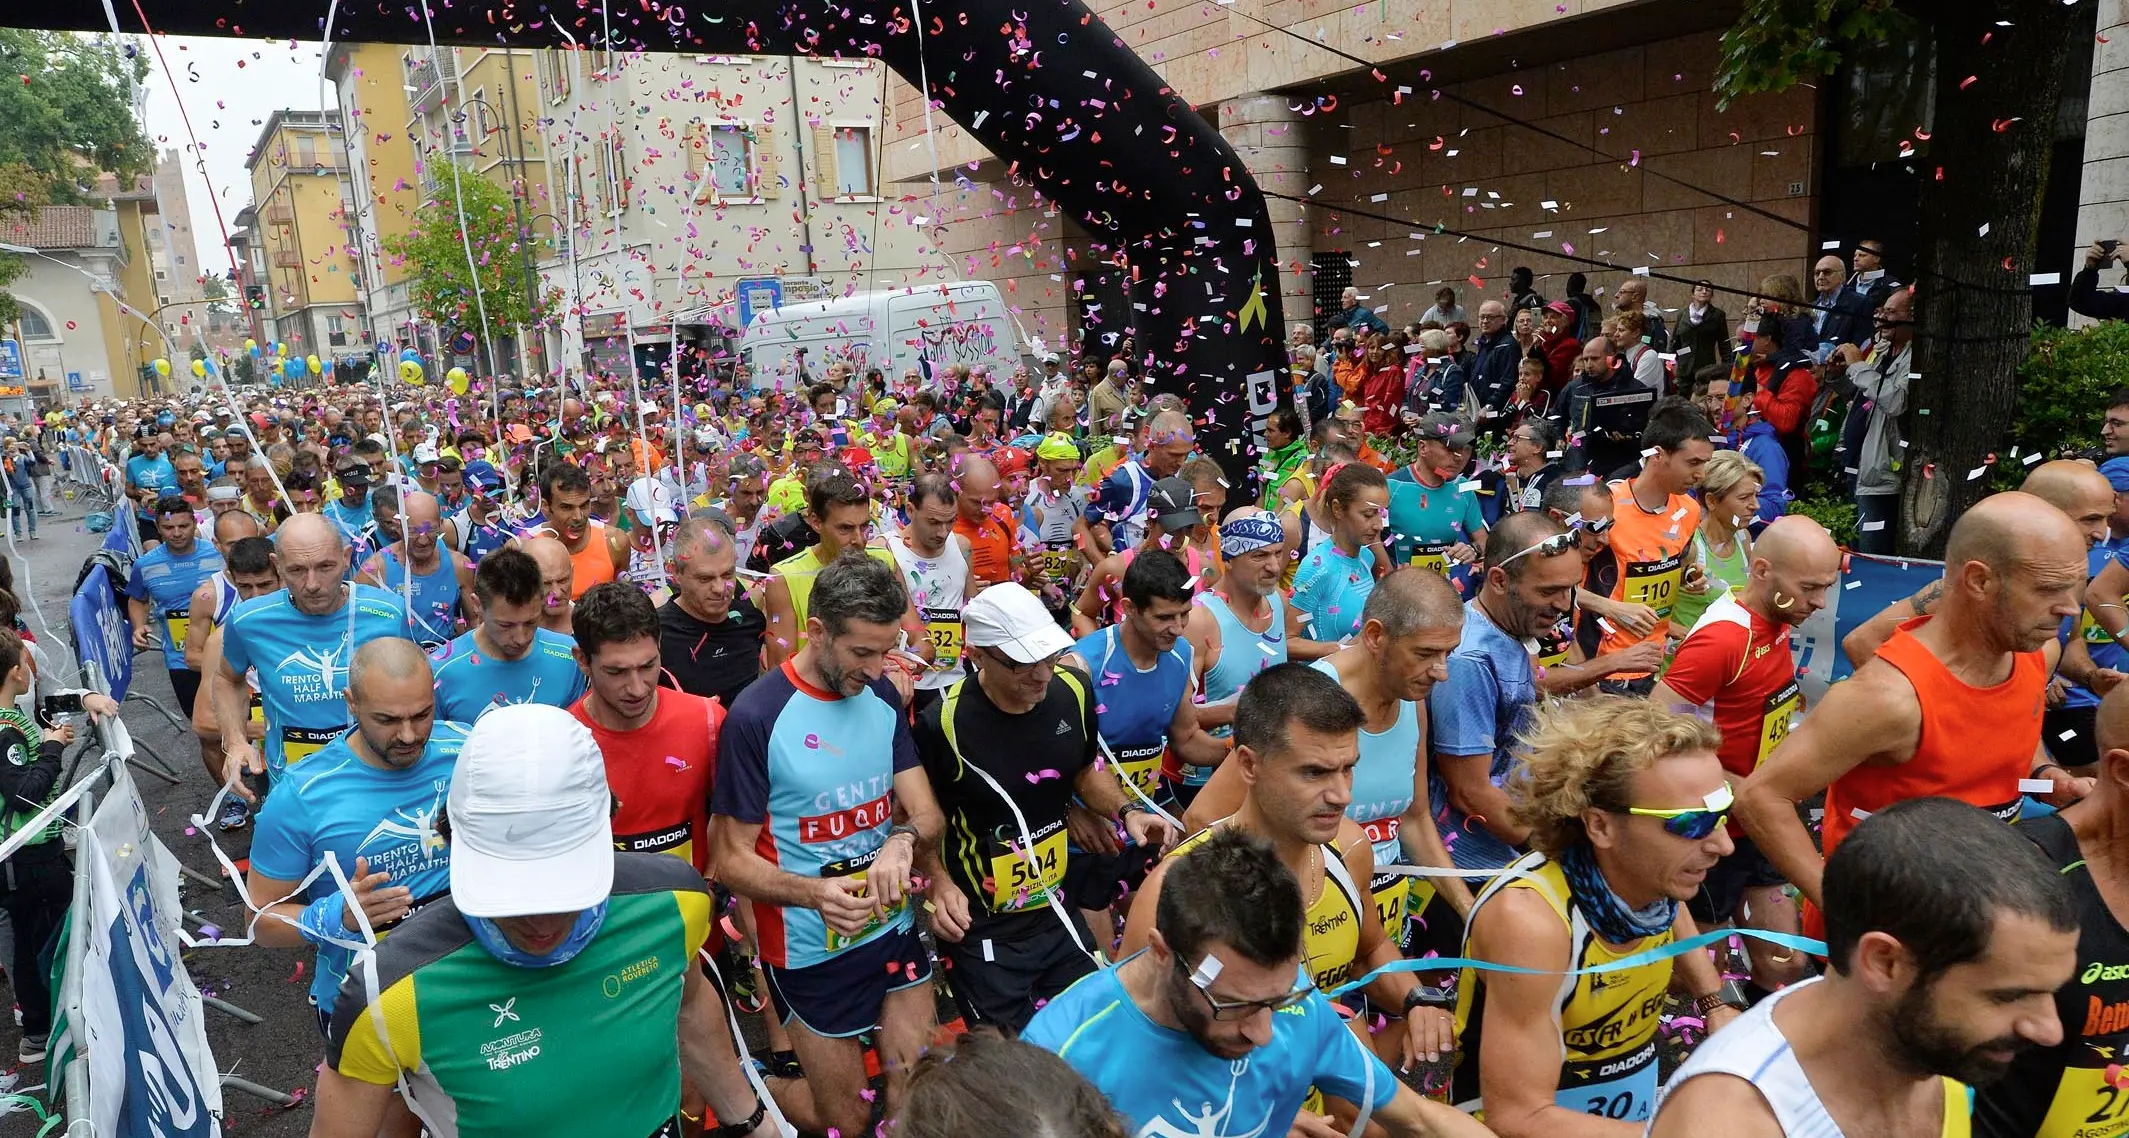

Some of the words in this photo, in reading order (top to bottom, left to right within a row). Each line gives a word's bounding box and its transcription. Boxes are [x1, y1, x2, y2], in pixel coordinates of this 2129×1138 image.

[1648, 559, 1679, 572] DIADORA
[1641, 580, 1671, 602] 110
[359, 606, 395, 619] DIADORA
[281, 675, 321, 685] TRENTO
[293, 685, 321, 693] HALF
[815, 772, 889, 812] GENTE
[634, 828, 688, 850] DIADORA
[1018, 820, 1063, 844] DADORA
[366, 843, 419, 867] TRENTO
[384, 854, 419, 872] HALF
[1011, 847, 1058, 888] 504
[1310, 911, 1348, 936] TRENTINO
[623, 963, 659, 983] ROVERETO
[480, 1028, 542, 1054] MONTURA
[486, 1046, 540, 1070] TRENTINO
[1600, 1042, 1656, 1076] DIADORA
